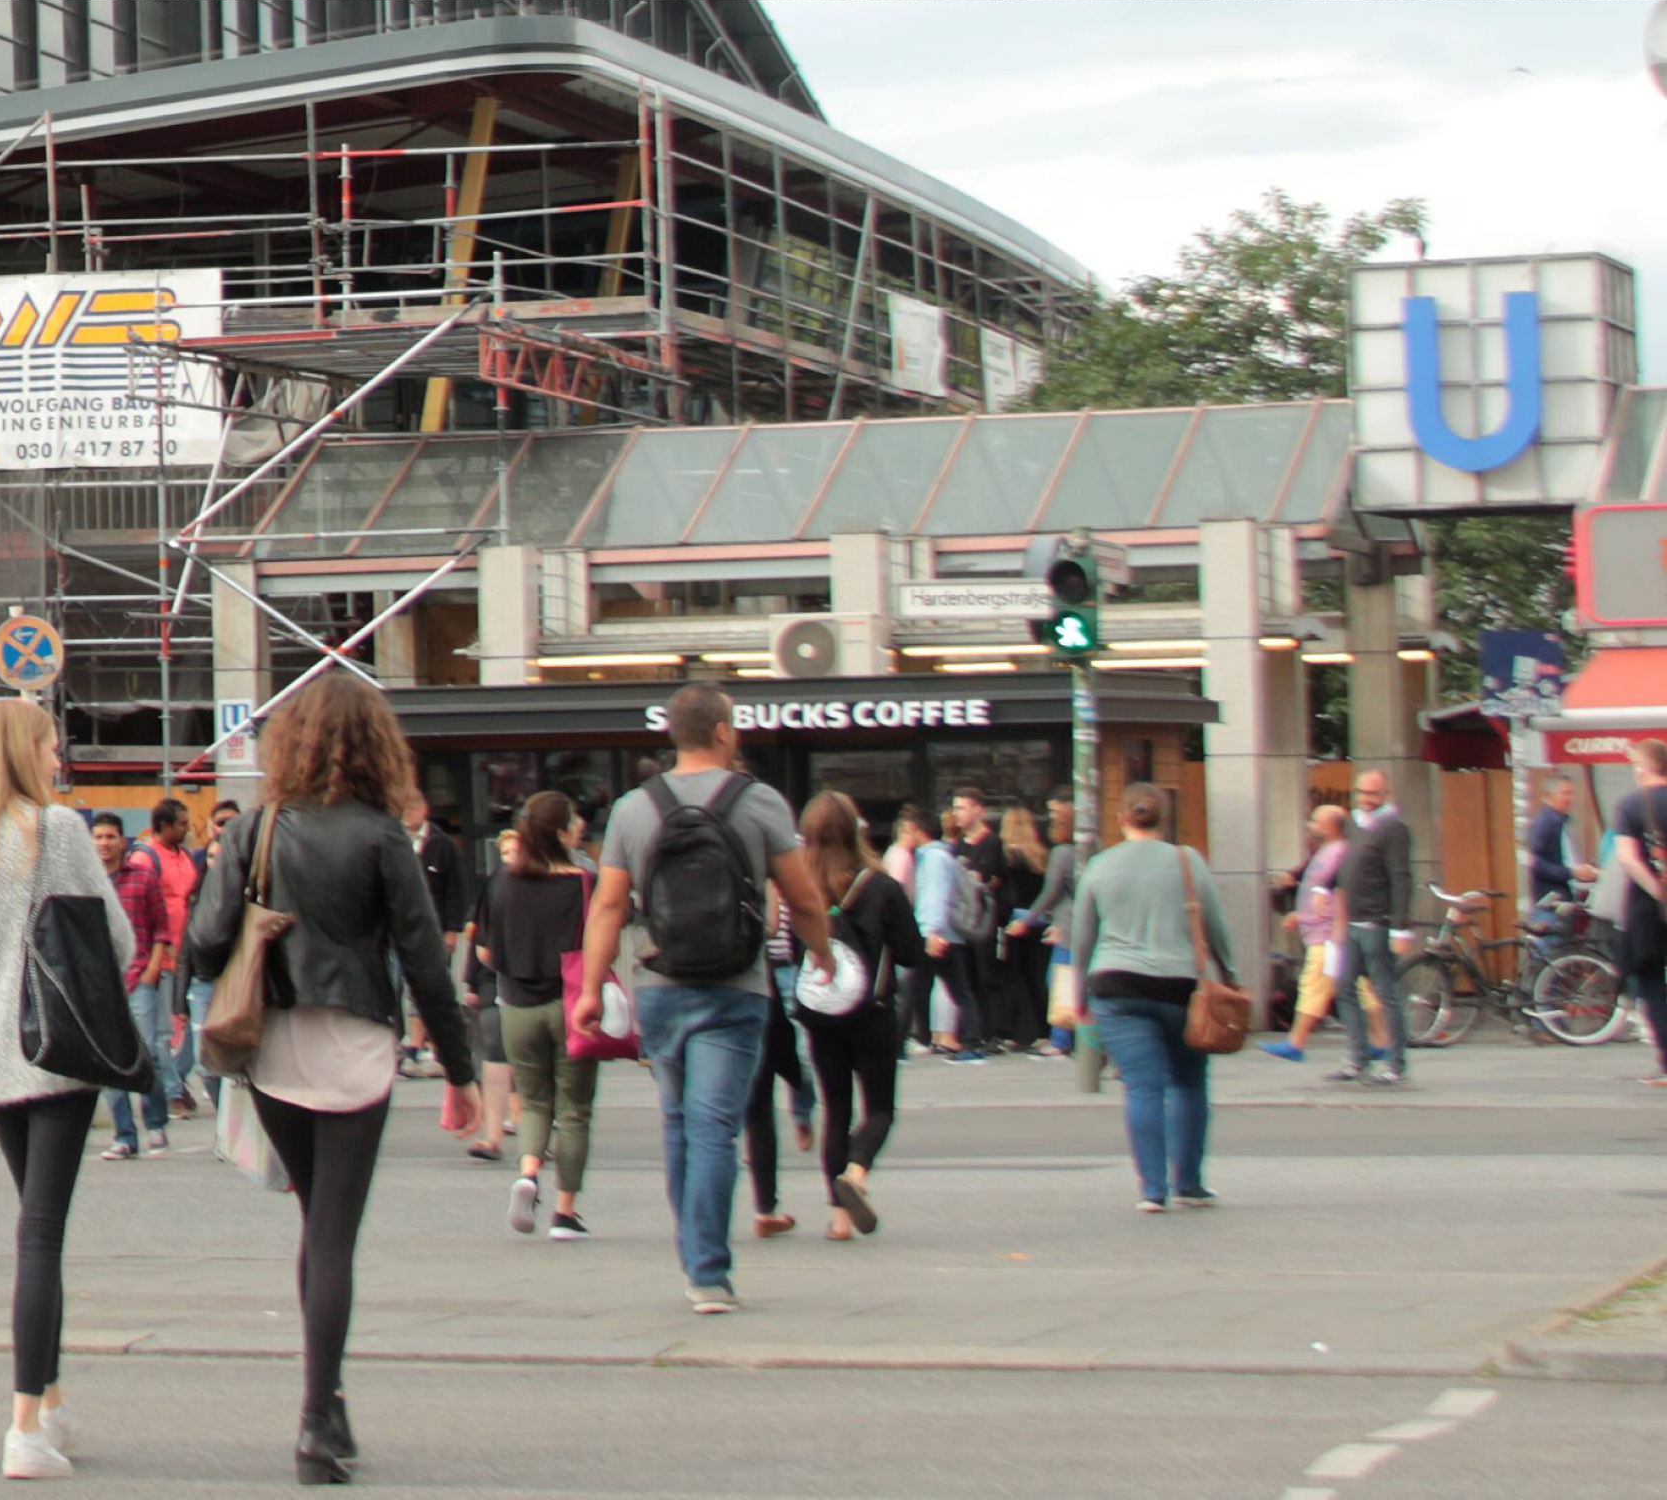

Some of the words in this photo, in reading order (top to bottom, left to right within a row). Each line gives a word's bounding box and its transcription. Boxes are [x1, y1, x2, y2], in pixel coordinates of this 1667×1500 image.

[1403, 291, 1539, 472] U
[111, 396, 176, 411] BAUR
[2, 414, 177, 431] INGENIEURBAU
[16, 442, 53, 460] 030
[59, 442, 67, 458] /
[74, 441, 113, 457] 417
[120, 440, 145, 457] 87
[645, 702, 851, 732] SBUCKS
[852, 699, 990, 728] COFFEE
